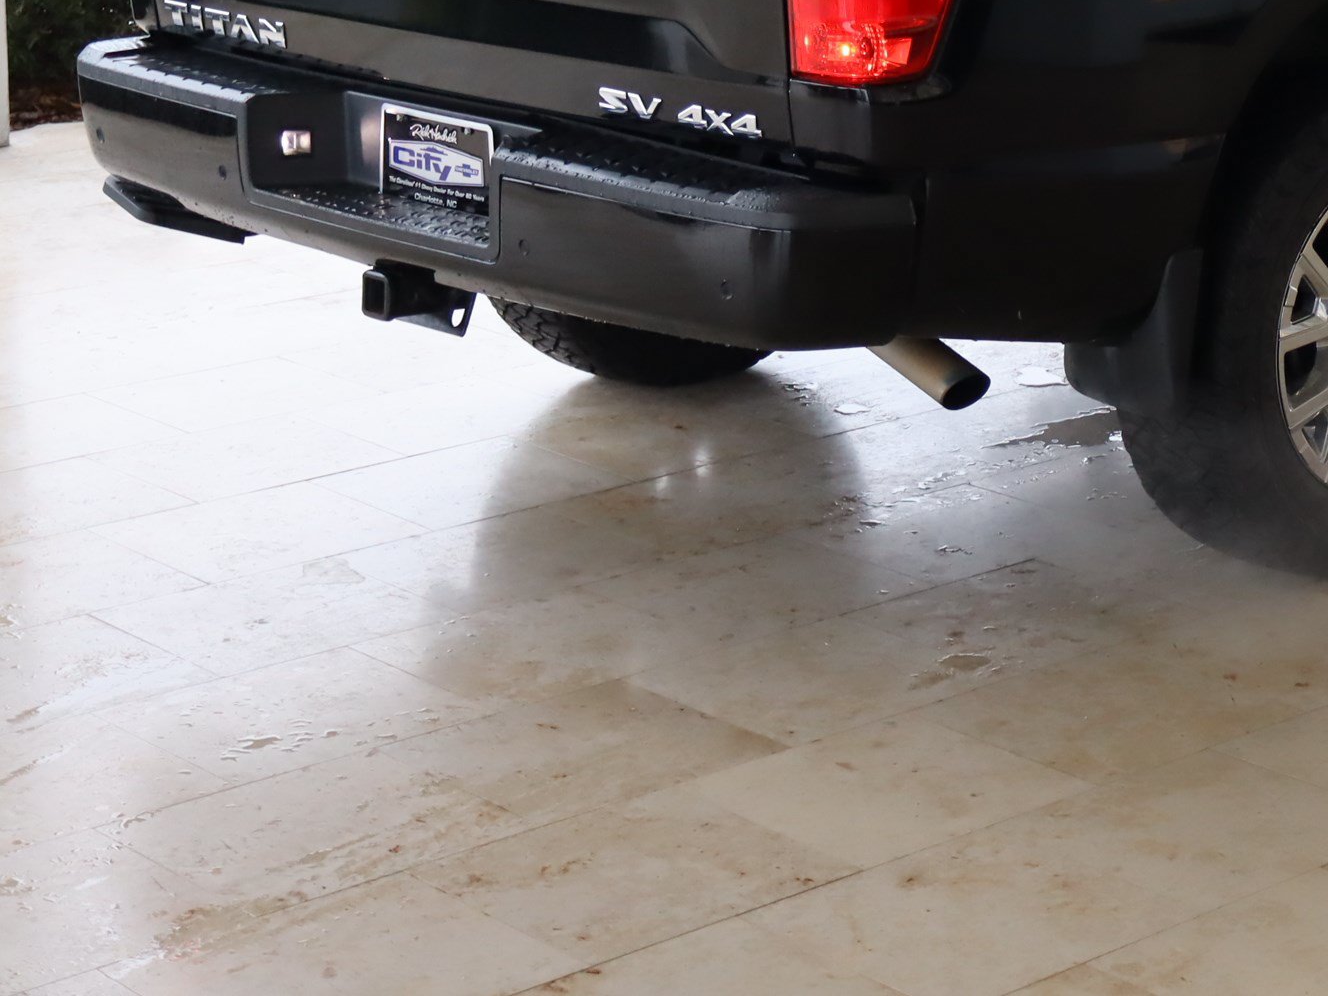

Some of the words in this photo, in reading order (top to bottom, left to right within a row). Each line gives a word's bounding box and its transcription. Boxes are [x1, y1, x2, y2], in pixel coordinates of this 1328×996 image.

[598, 87, 662, 119] SV
[393, 145, 452, 181] City
[446, 199, 458, 209] NC
